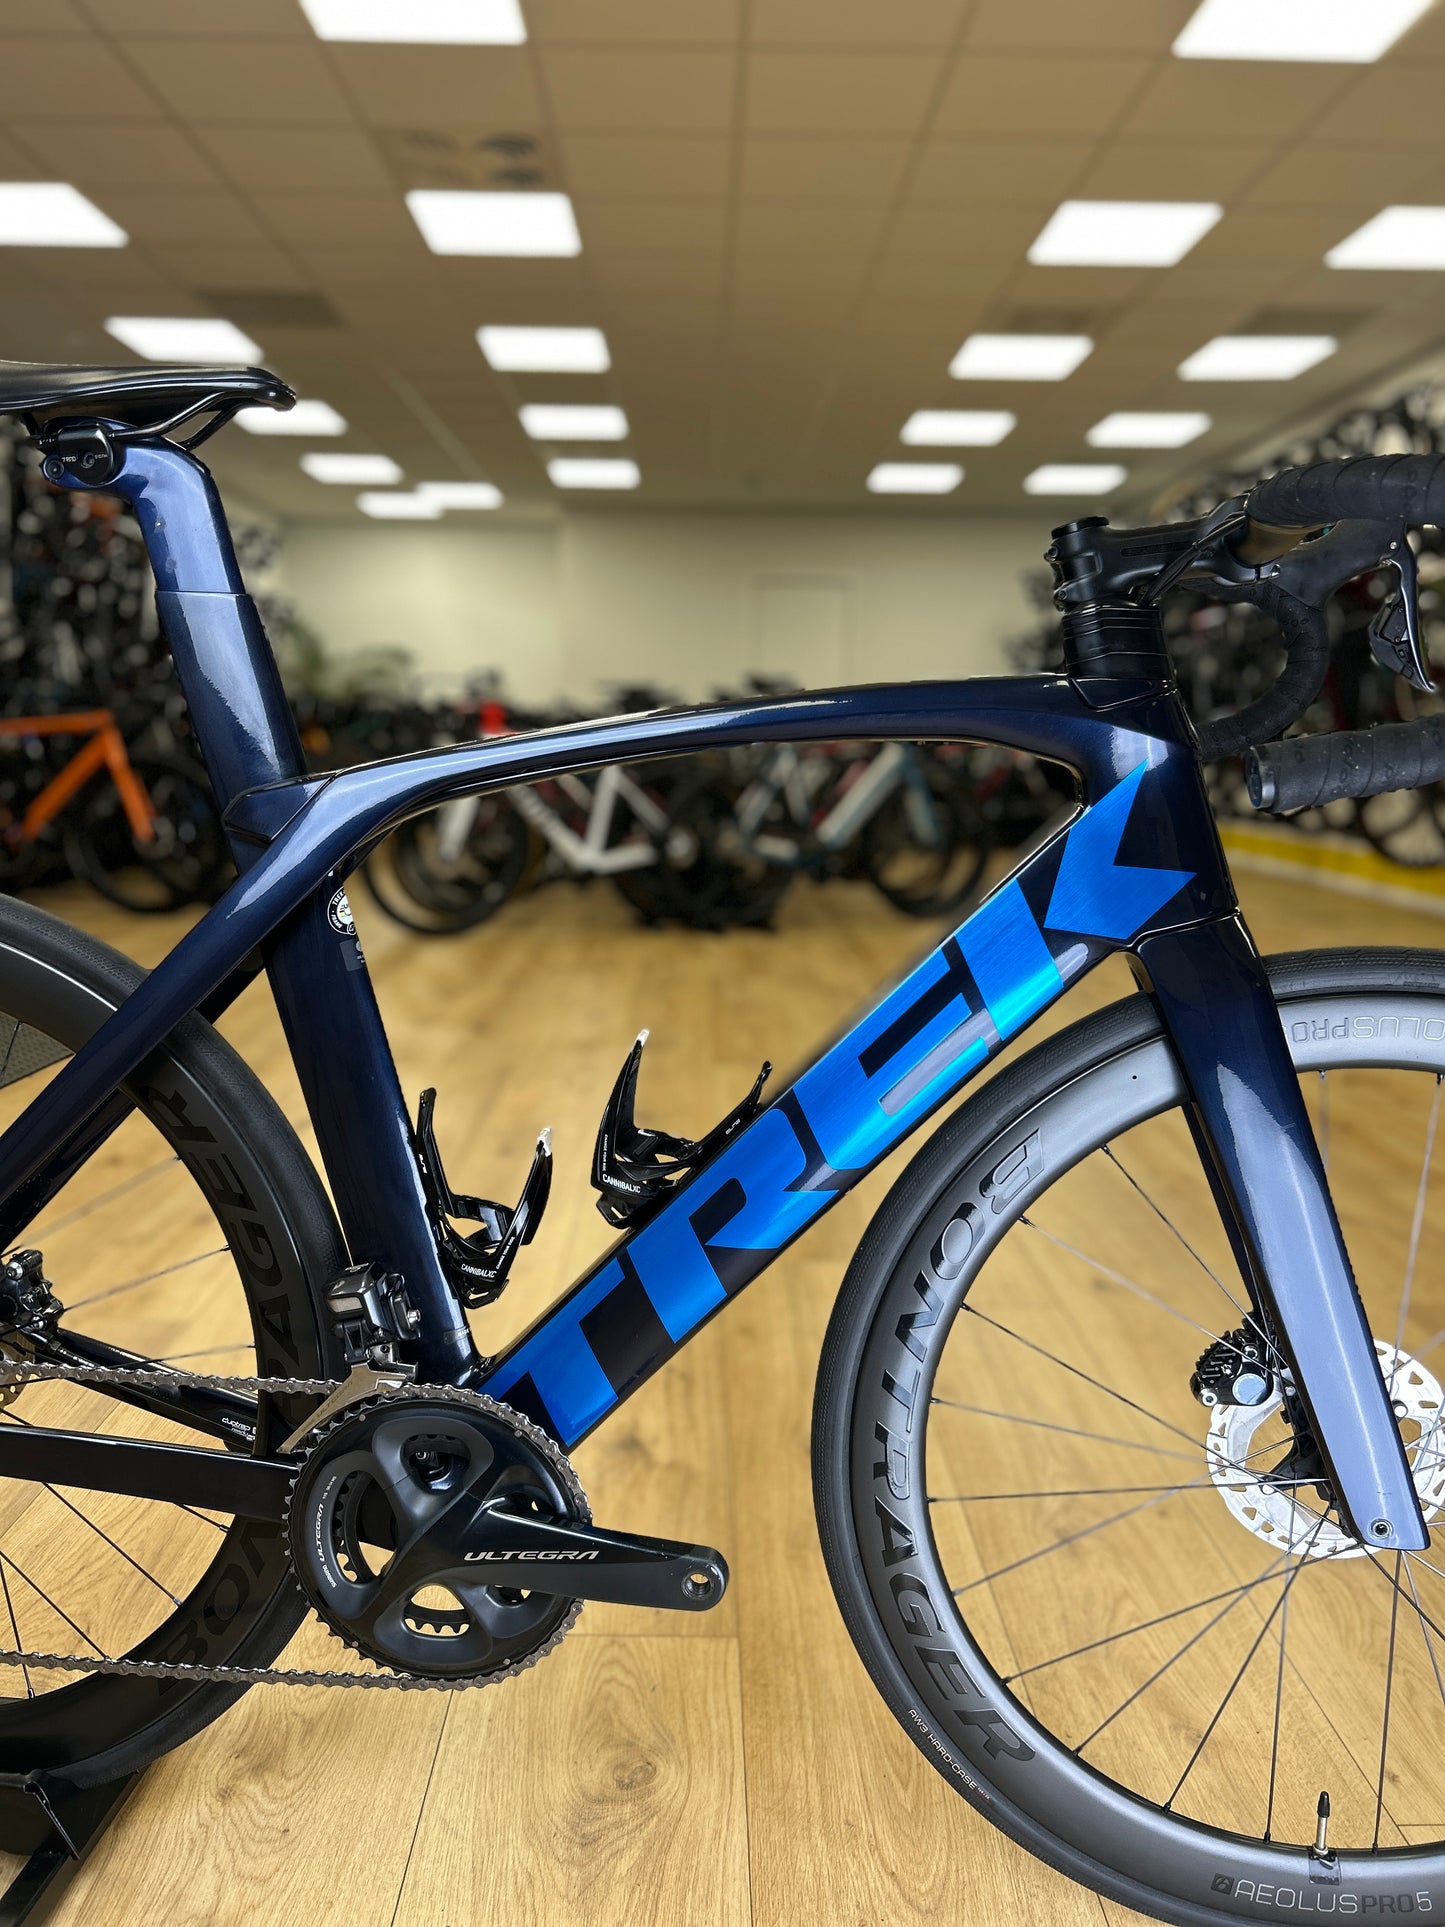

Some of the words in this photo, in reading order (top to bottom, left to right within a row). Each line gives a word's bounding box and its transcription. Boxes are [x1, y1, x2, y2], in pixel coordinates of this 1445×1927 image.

[480, 758, 1197, 1447] TREK
[873, 1128, 1044, 1762] BONTRAGER
[315, 1503, 325, 1562] ULTEGRA
[463, 1550, 600, 1561] ULTEGRA
[908, 1709, 928, 1733] AW3
[927, 1733, 978, 1790] HARD-CASE
